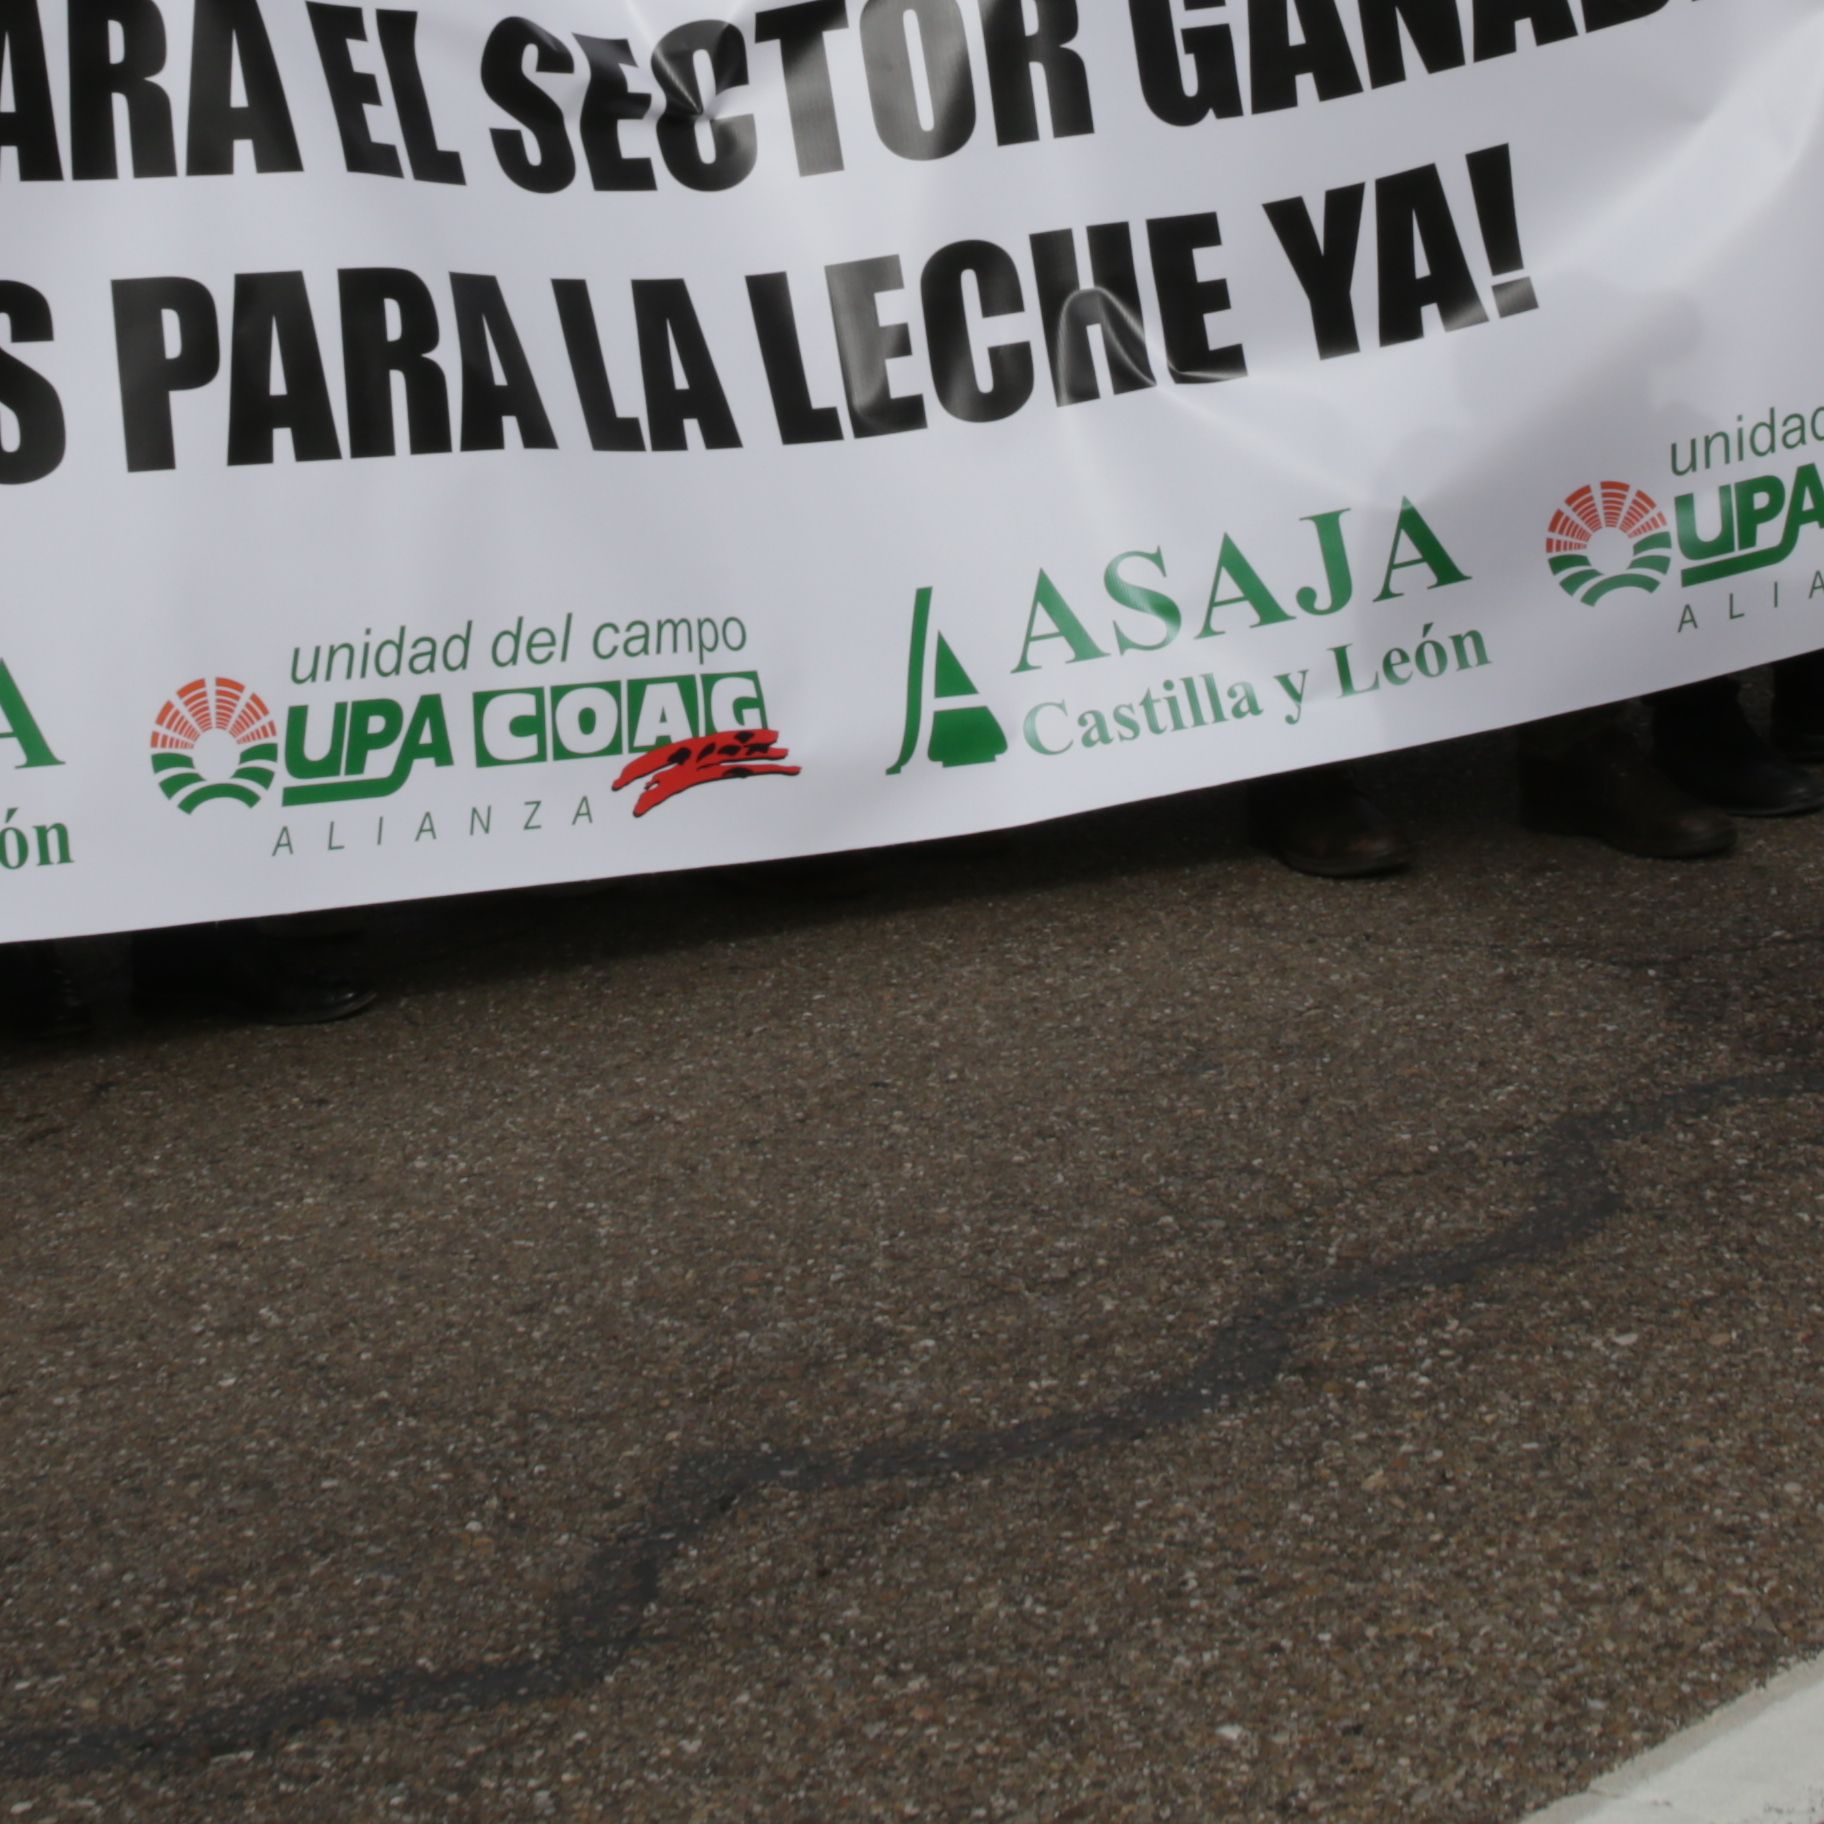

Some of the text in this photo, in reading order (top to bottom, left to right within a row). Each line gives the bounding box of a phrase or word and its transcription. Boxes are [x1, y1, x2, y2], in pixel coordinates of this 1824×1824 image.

[109, 267, 559, 473] PARA
[550, 278, 744, 453] LA
[745, 210, 1248, 446] LECHE
[1262, 142, 1540, 360] YA!
[290, 612, 749, 686] unidad del campo
[1010, 495, 1473, 675] ASAJA
[281, 670, 769, 808] UPA COAG
[1021, 622, 1494, 757] Castilla y León
[271, 794, 595, 858] ALIANZA
